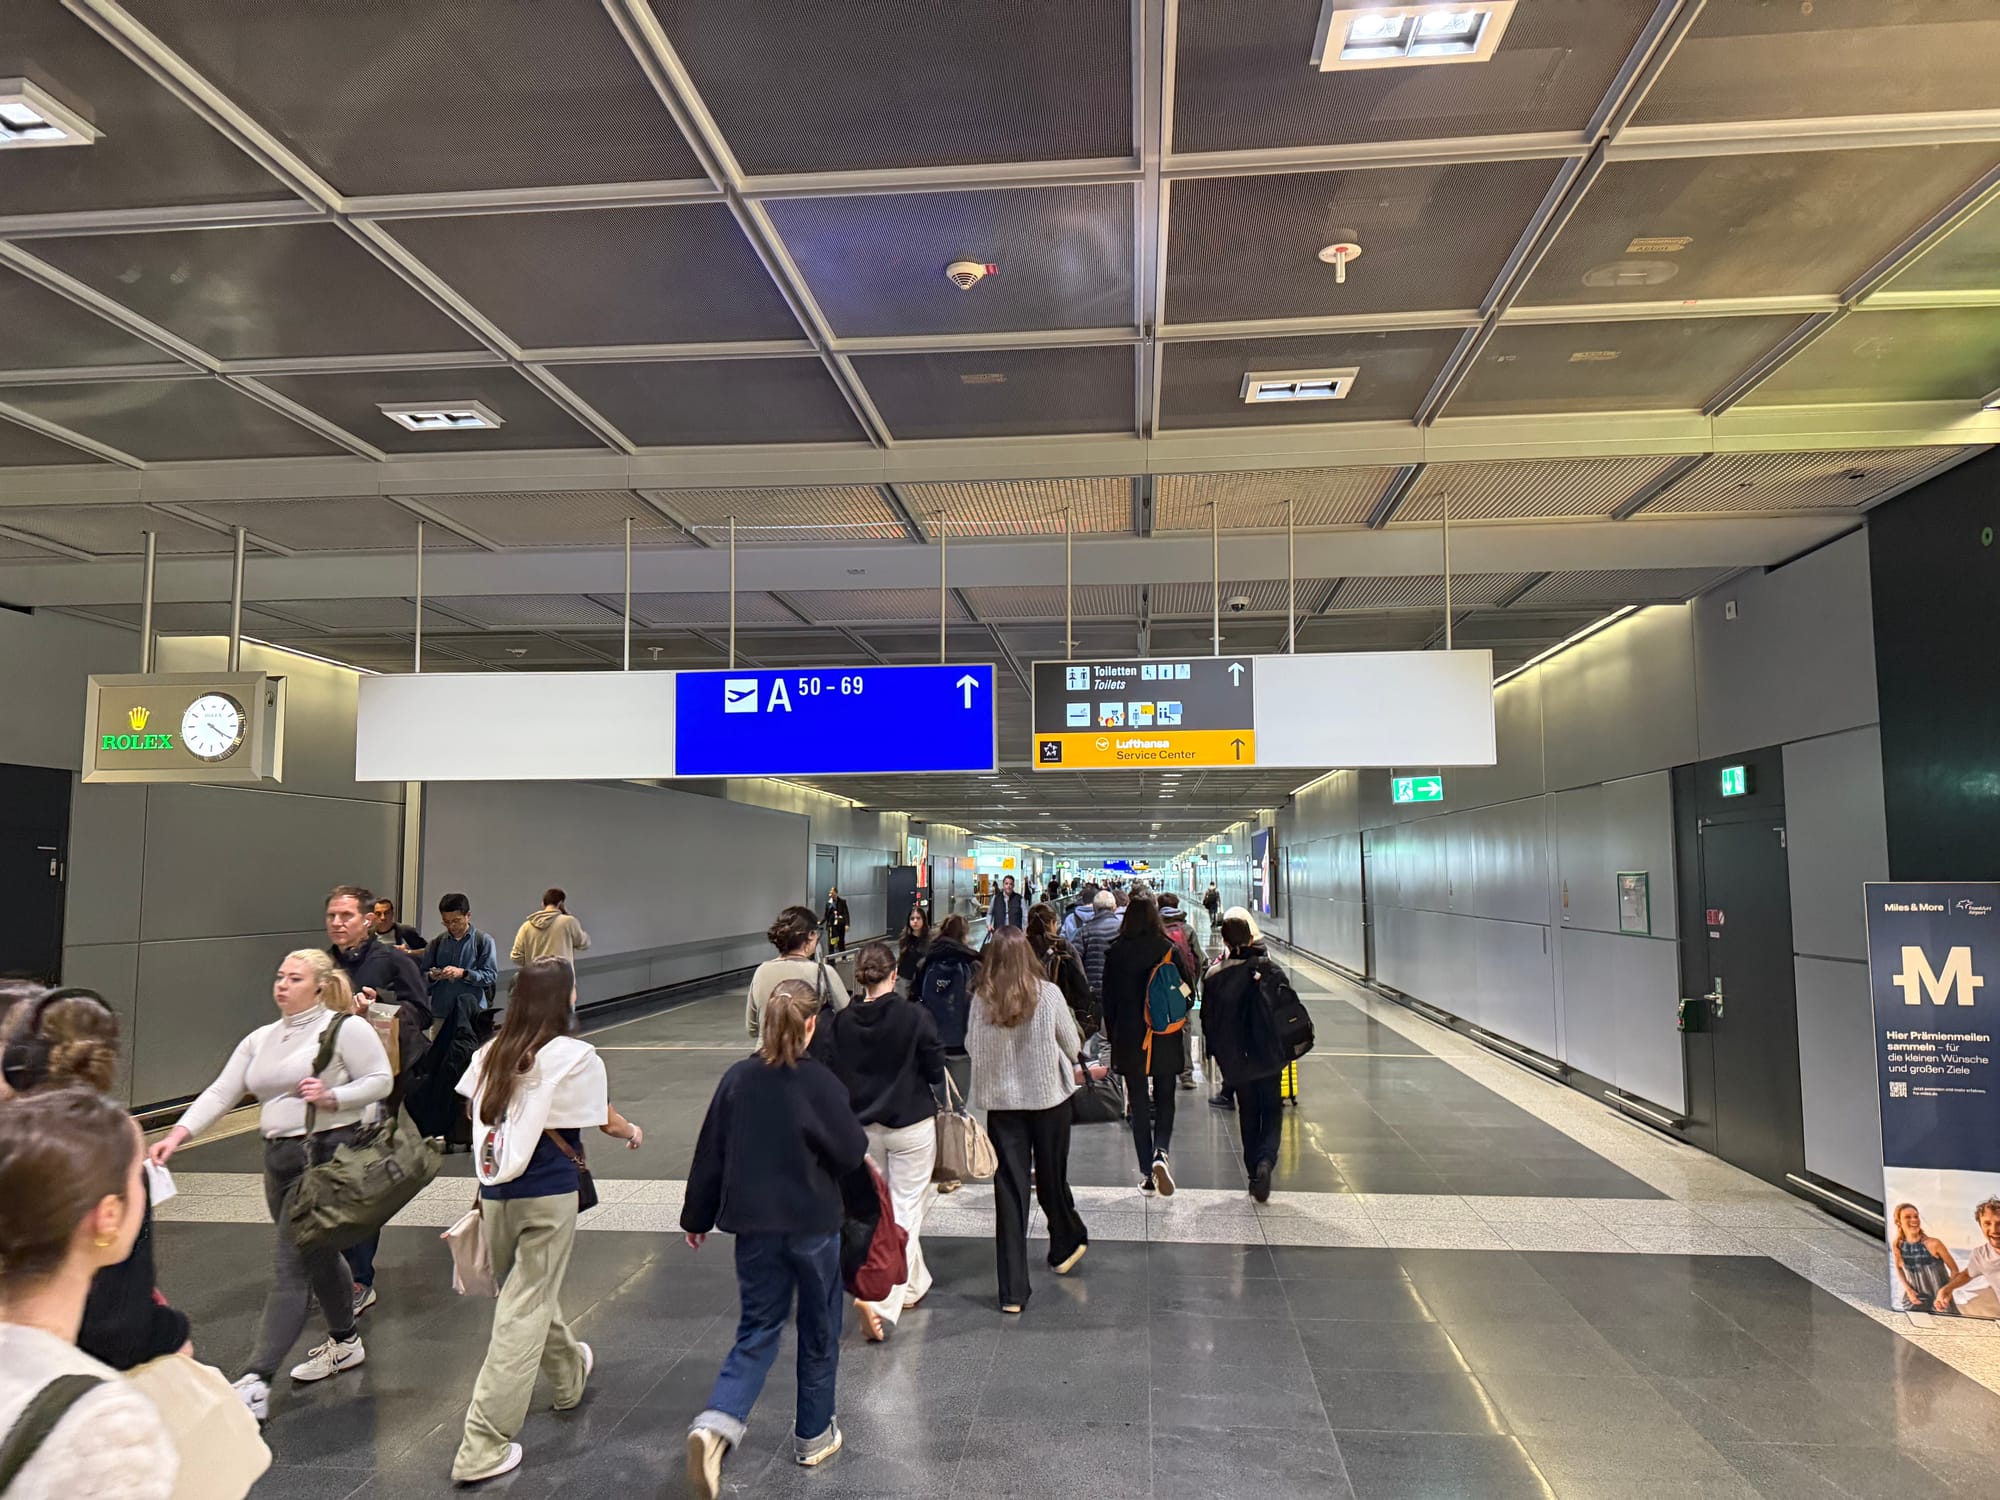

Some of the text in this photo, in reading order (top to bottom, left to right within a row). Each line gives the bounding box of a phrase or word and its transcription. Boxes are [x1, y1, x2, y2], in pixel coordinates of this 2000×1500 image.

[1093, 666, 1137, 677] Toiletten
[1094, 679, 1126, 690] Toilets
[766, 678, 792, 713] A
[798, 677, 821, 695] 50
[841, 676, 863, 694] 69
[102, 734, 173, 750] ROLEX
[1115, 738, 1170, 750] Lufthansa
[1116, 750, 1196, 760] Service Center
[1884, 903, 1944, 912] Miles & More
[1886, 1031, 1990, 1042] Hier Prämienmeilen
[1887, 1043, 1936, 1051] sammeln
[1945, 1043, 1960, 1052] für
[1887, 1053, 1989, 1064] die kleinen Wünsche
[1888, 1064, 1970, 1075] und großen Ziele
